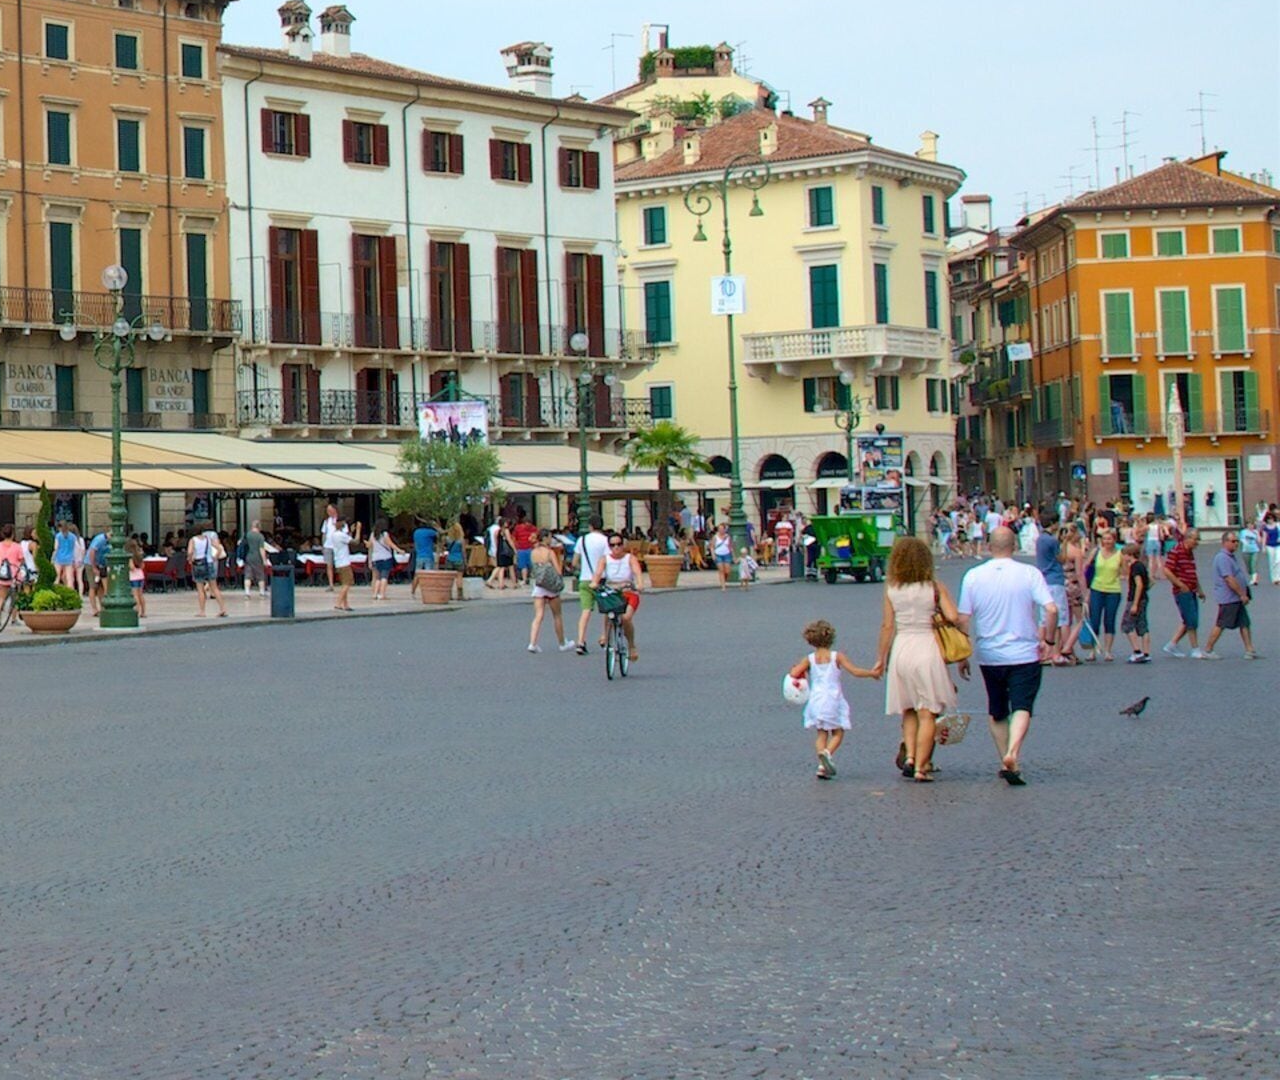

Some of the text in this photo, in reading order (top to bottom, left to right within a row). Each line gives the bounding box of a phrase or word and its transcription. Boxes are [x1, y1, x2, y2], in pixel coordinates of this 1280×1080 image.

[8, 364, 53, 380] BANCA
[150, 368, 191, 384] BANCA
[15, 382, 45, 393] CAMBIO
[11, 398, 53, 409] EXCHANGE
[1147, 466, 1214, 475] intimssimi
